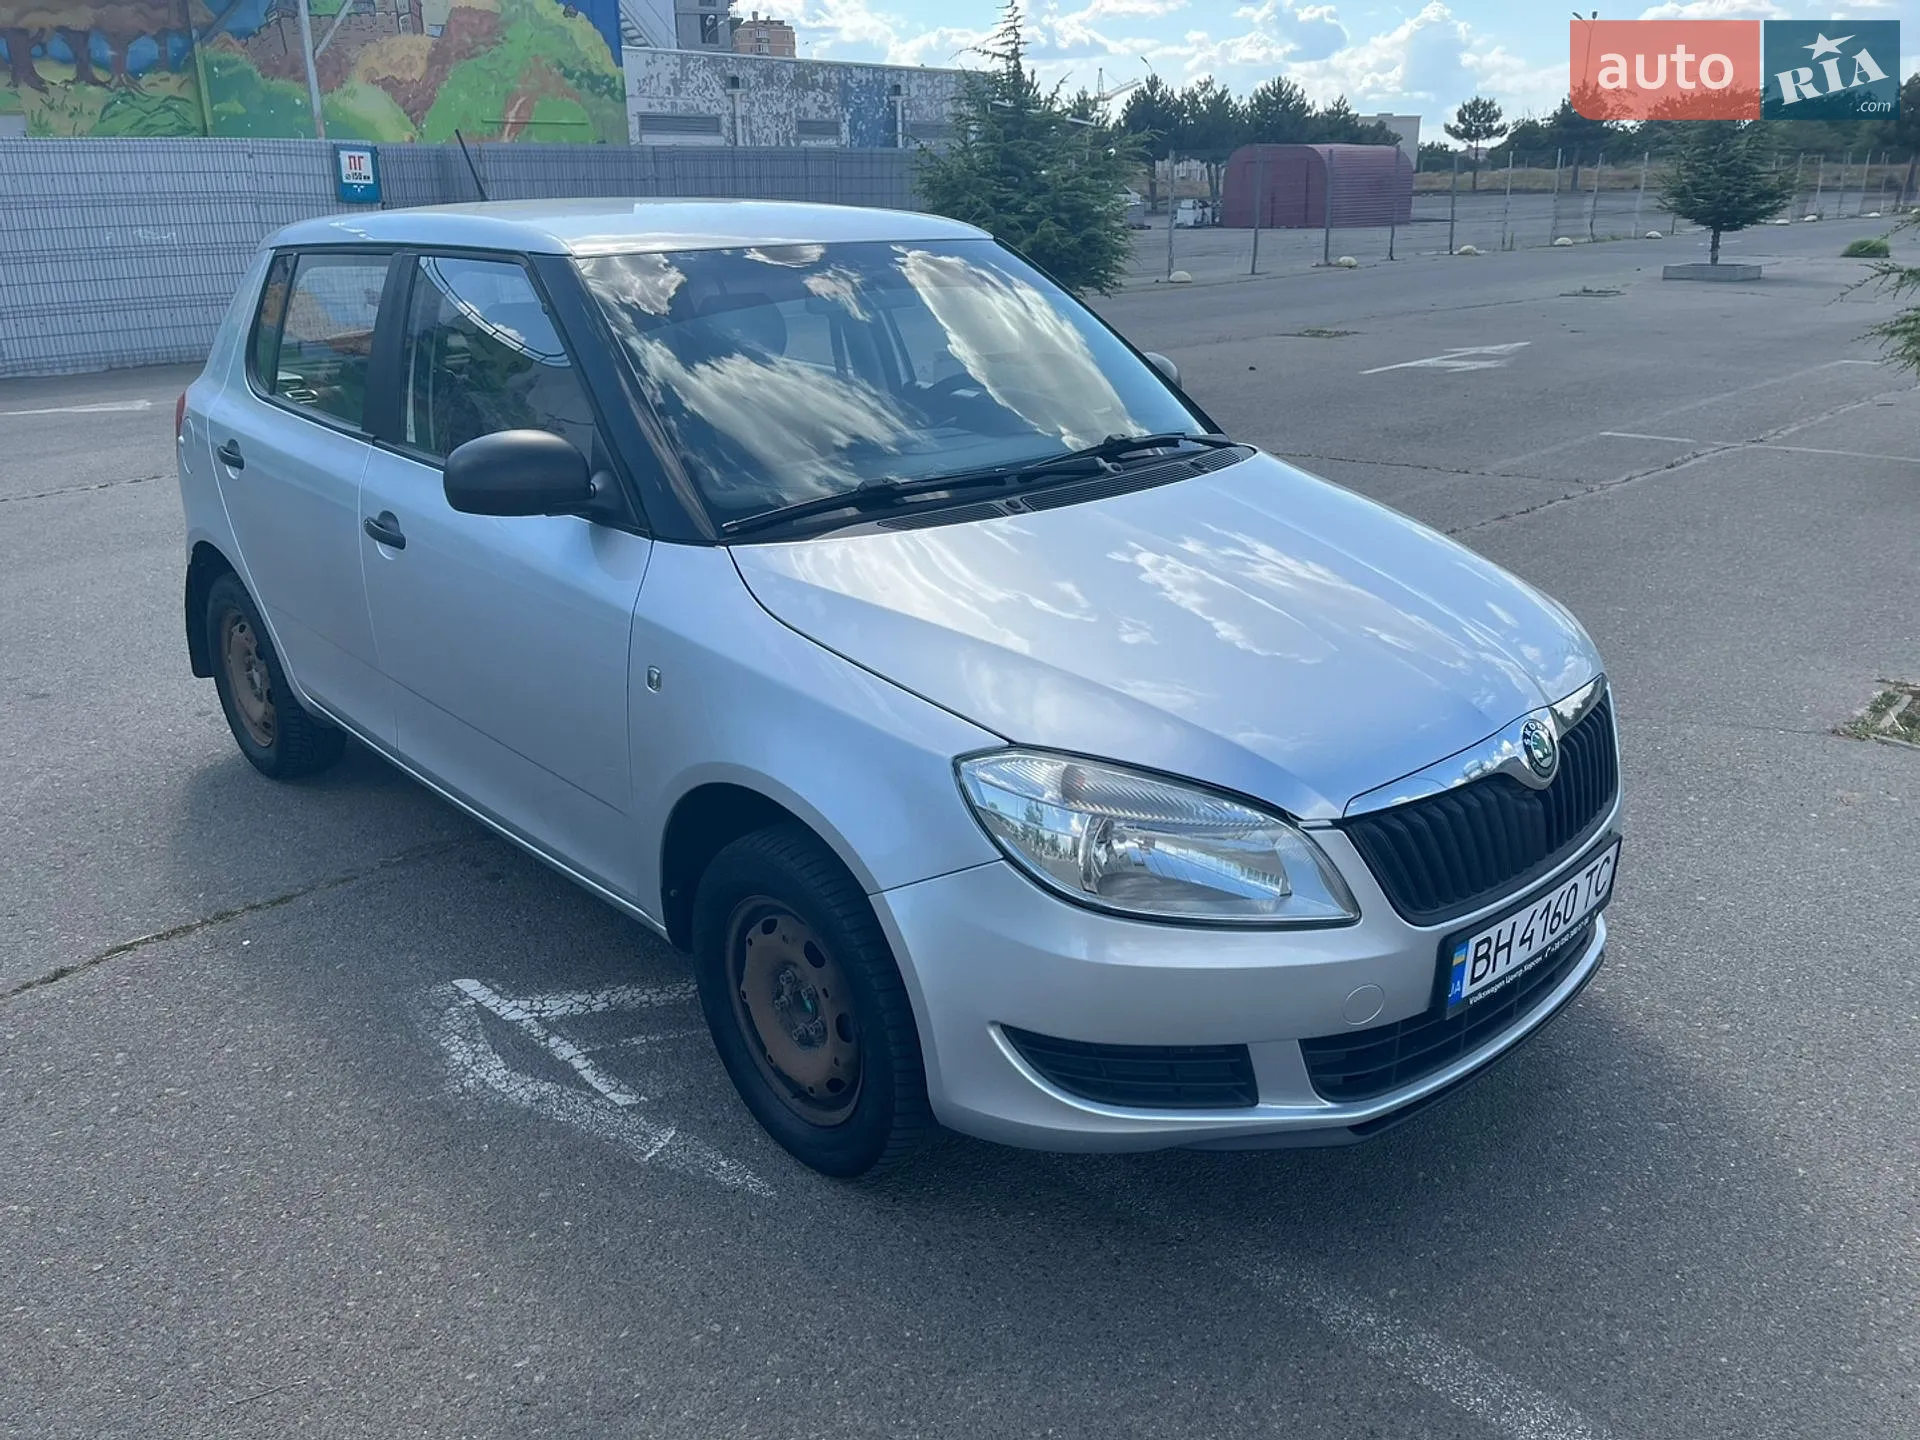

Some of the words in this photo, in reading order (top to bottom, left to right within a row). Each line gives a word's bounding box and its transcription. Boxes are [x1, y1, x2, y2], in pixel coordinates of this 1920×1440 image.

[348, 155, 364, 170] ПГ
[1469, 920, 1517, 986] BH
[1519, 882, 1579, 952] 4160
[1585, 855, 1611, 910] TC
